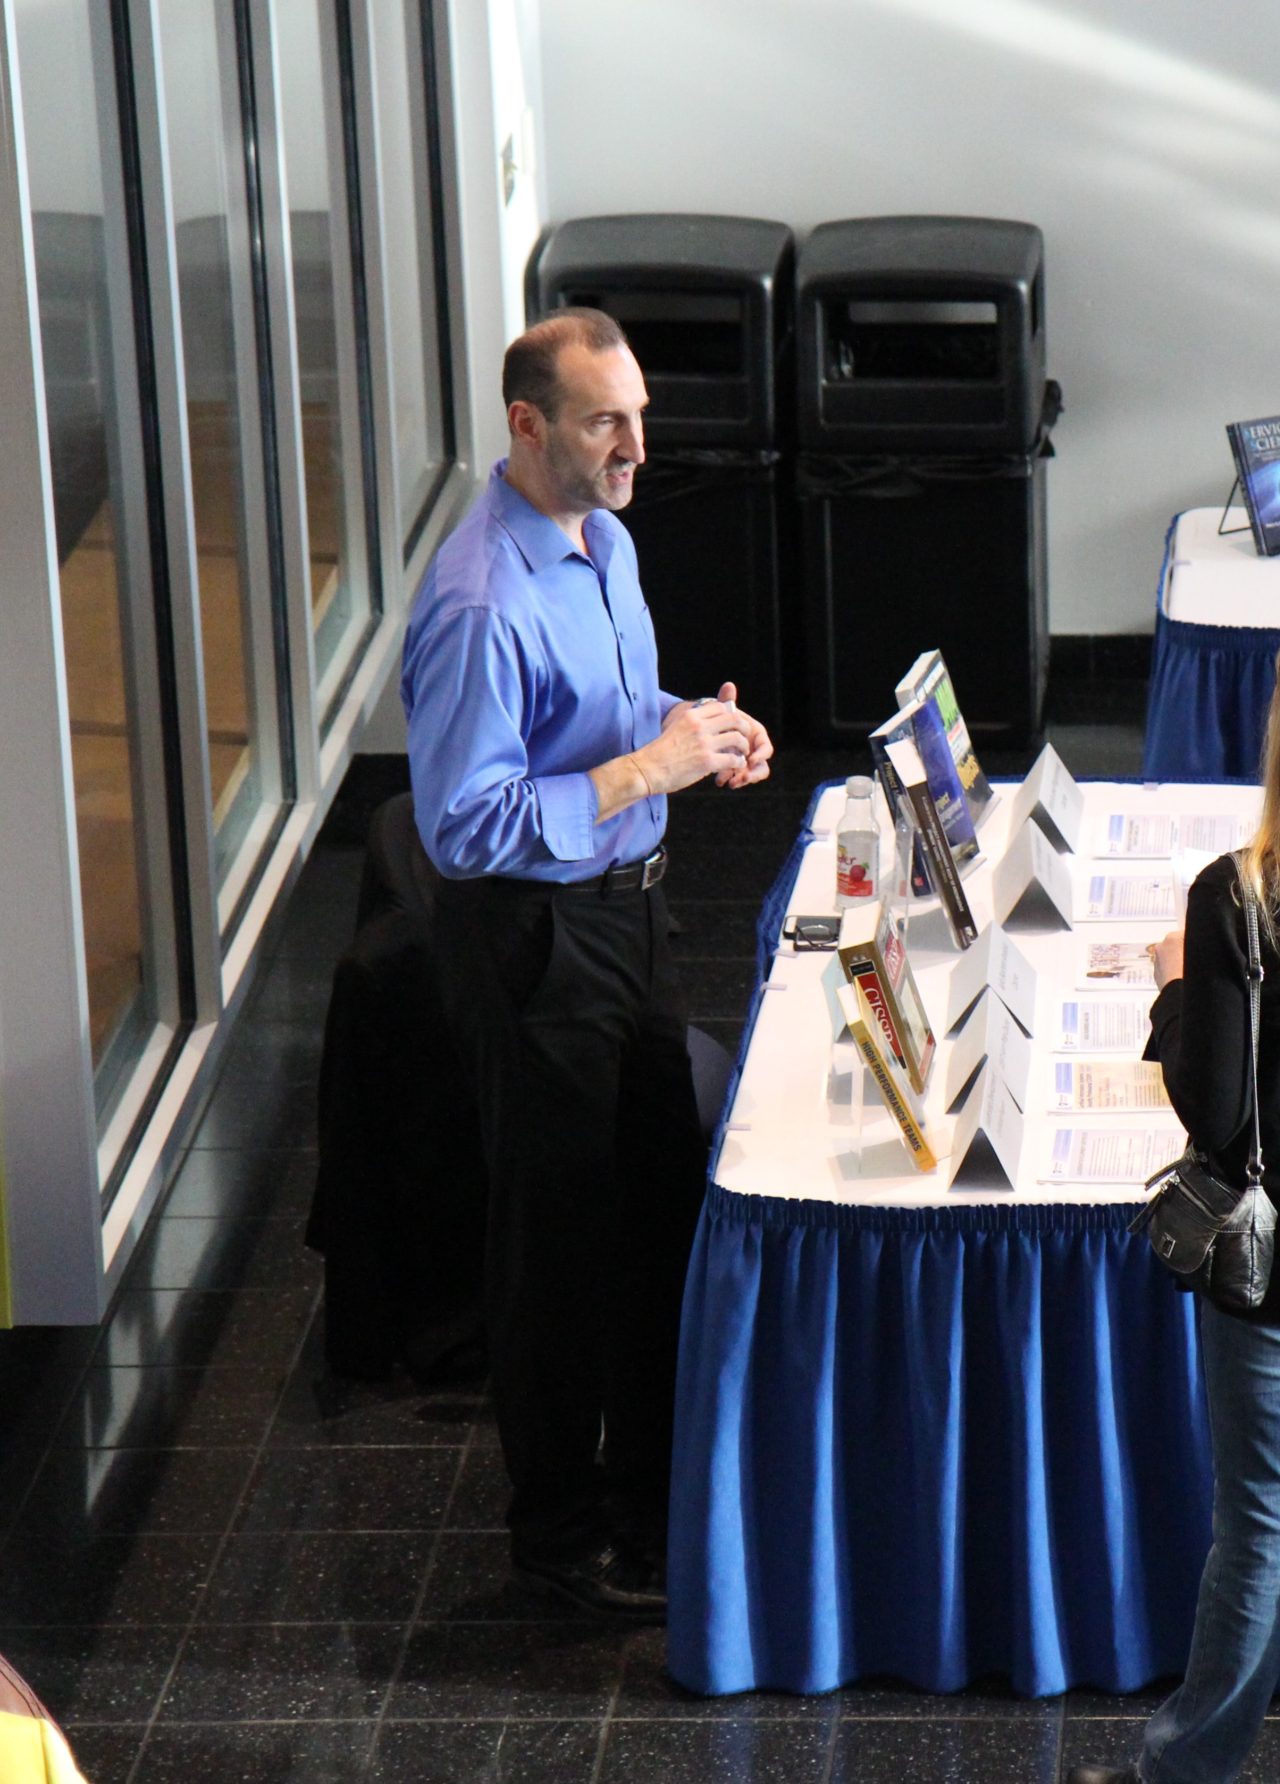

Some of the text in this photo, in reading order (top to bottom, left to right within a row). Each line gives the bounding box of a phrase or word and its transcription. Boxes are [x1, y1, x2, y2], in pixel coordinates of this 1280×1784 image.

[883, 761, 899, 794] Project
[861, 1041, 923, 1153] HIGH PERFORMANCE TEAMS
